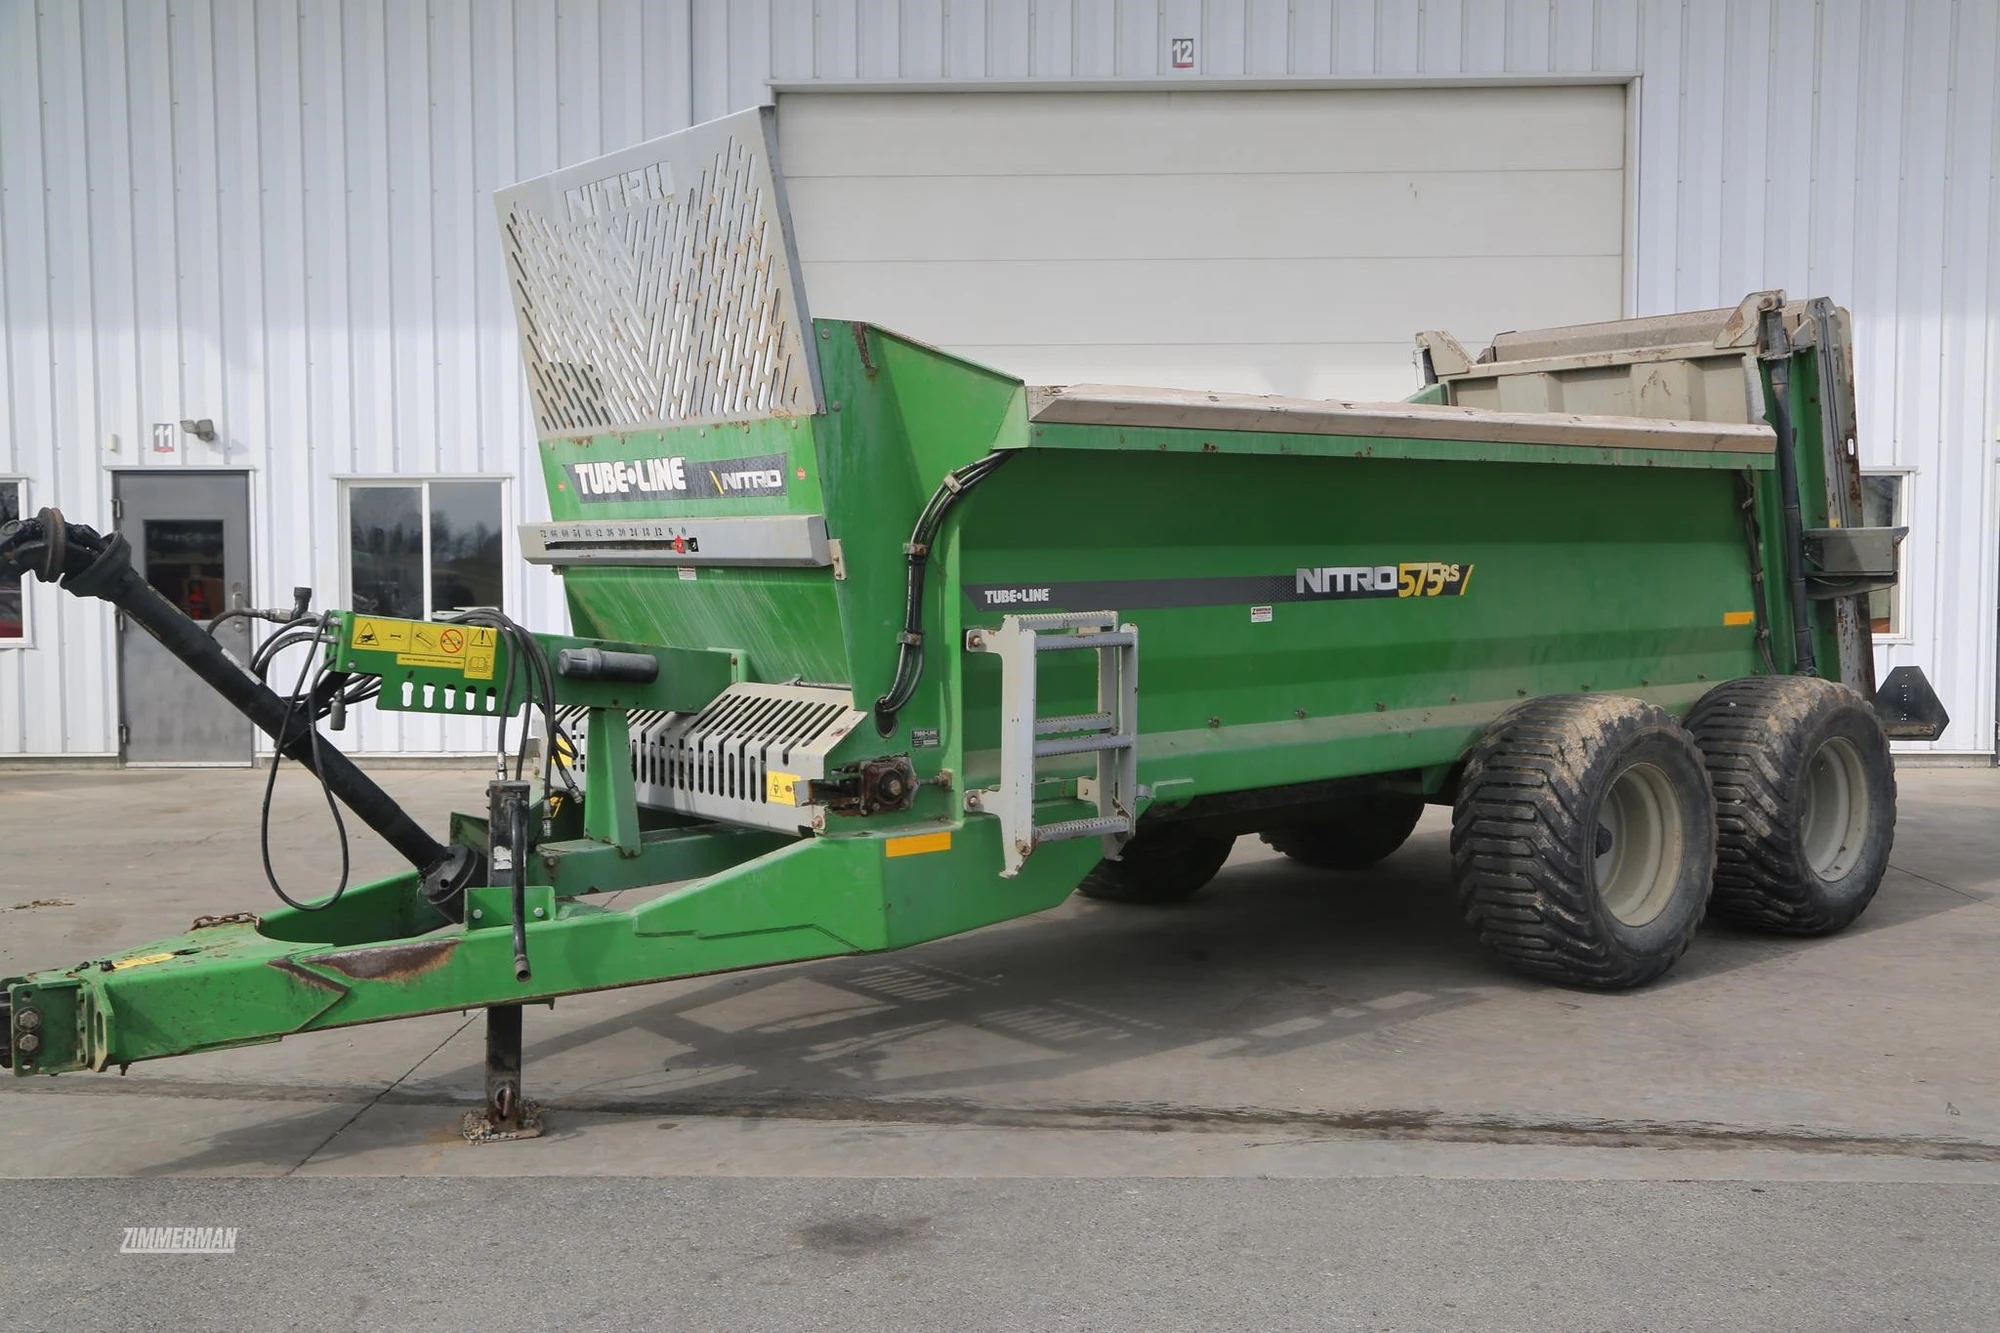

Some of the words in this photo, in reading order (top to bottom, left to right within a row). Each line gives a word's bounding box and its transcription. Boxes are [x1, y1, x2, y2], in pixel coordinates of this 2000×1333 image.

[1173, 40, 1193, 64] 12
[154, 424, 173, 448] 11
[721, 469, 782, 491] NITRO
[1296, 565, 1398, 594] NITRO
